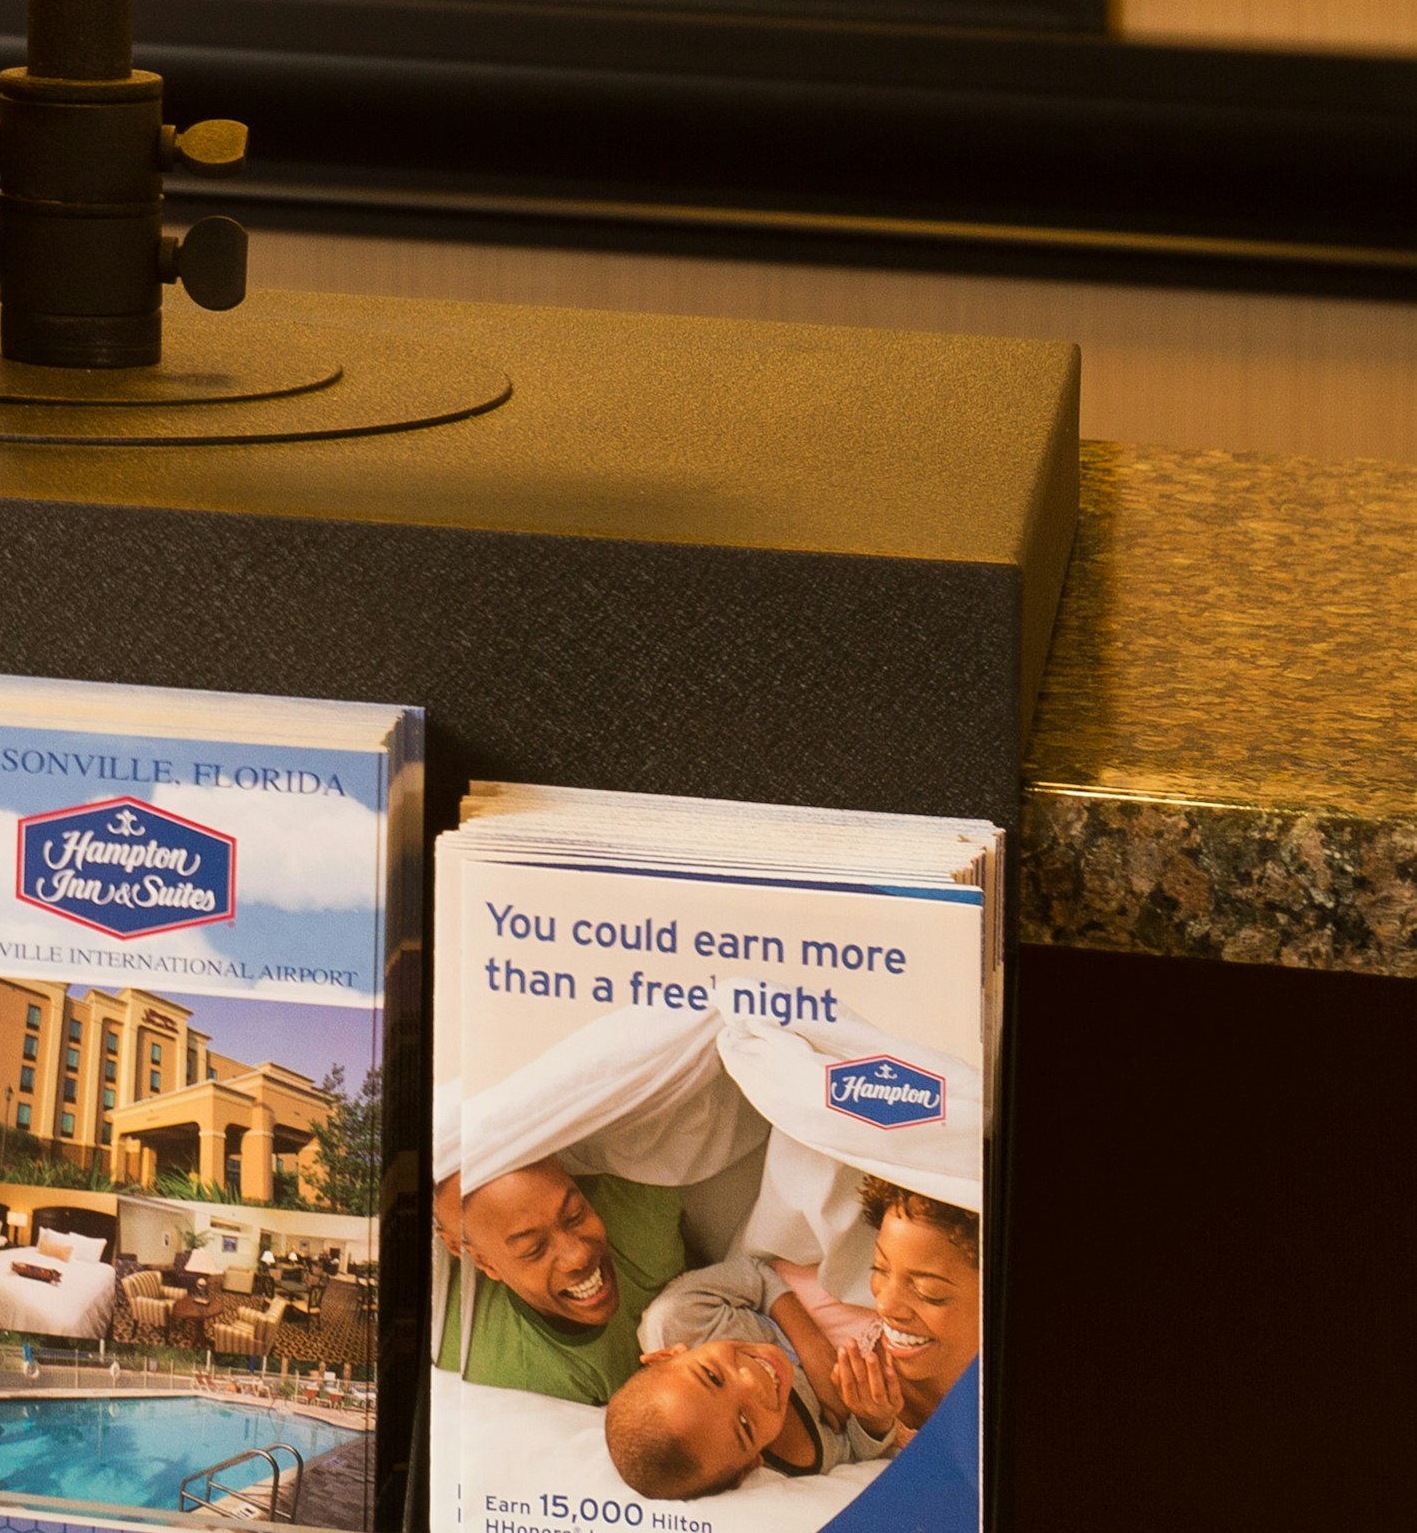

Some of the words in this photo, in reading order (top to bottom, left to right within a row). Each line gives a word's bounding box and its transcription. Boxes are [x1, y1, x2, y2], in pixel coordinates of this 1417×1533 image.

[193, 763, 346, 797] FLORIDA
[43, 830, 201, 876] Hampton
[36, 869, 115, 905] Inn
[114, 882, 135, 908] &
[132, 875, 216, 912] Suites
[485, 902, 556, 943] You
[572, 918, 678, 954] could
[694, 930, 785, 964] earn
[802, 941, 907, 975] more
[70, 948, 254, 980] INTERNATIONAL
[259, 964, 359, 989] AIRPORT
[485, 958, 576, 1000] than
[592, 978, 614, 1004] a
[733, 981, 838, 1026] night
[830, 1075, 940, 1109] Hampton
[485, 1495, 531, 1515] Earn
[539, 1494, 644, 1527] 15,000
[652, 1512, 713, 1533] Hilton
